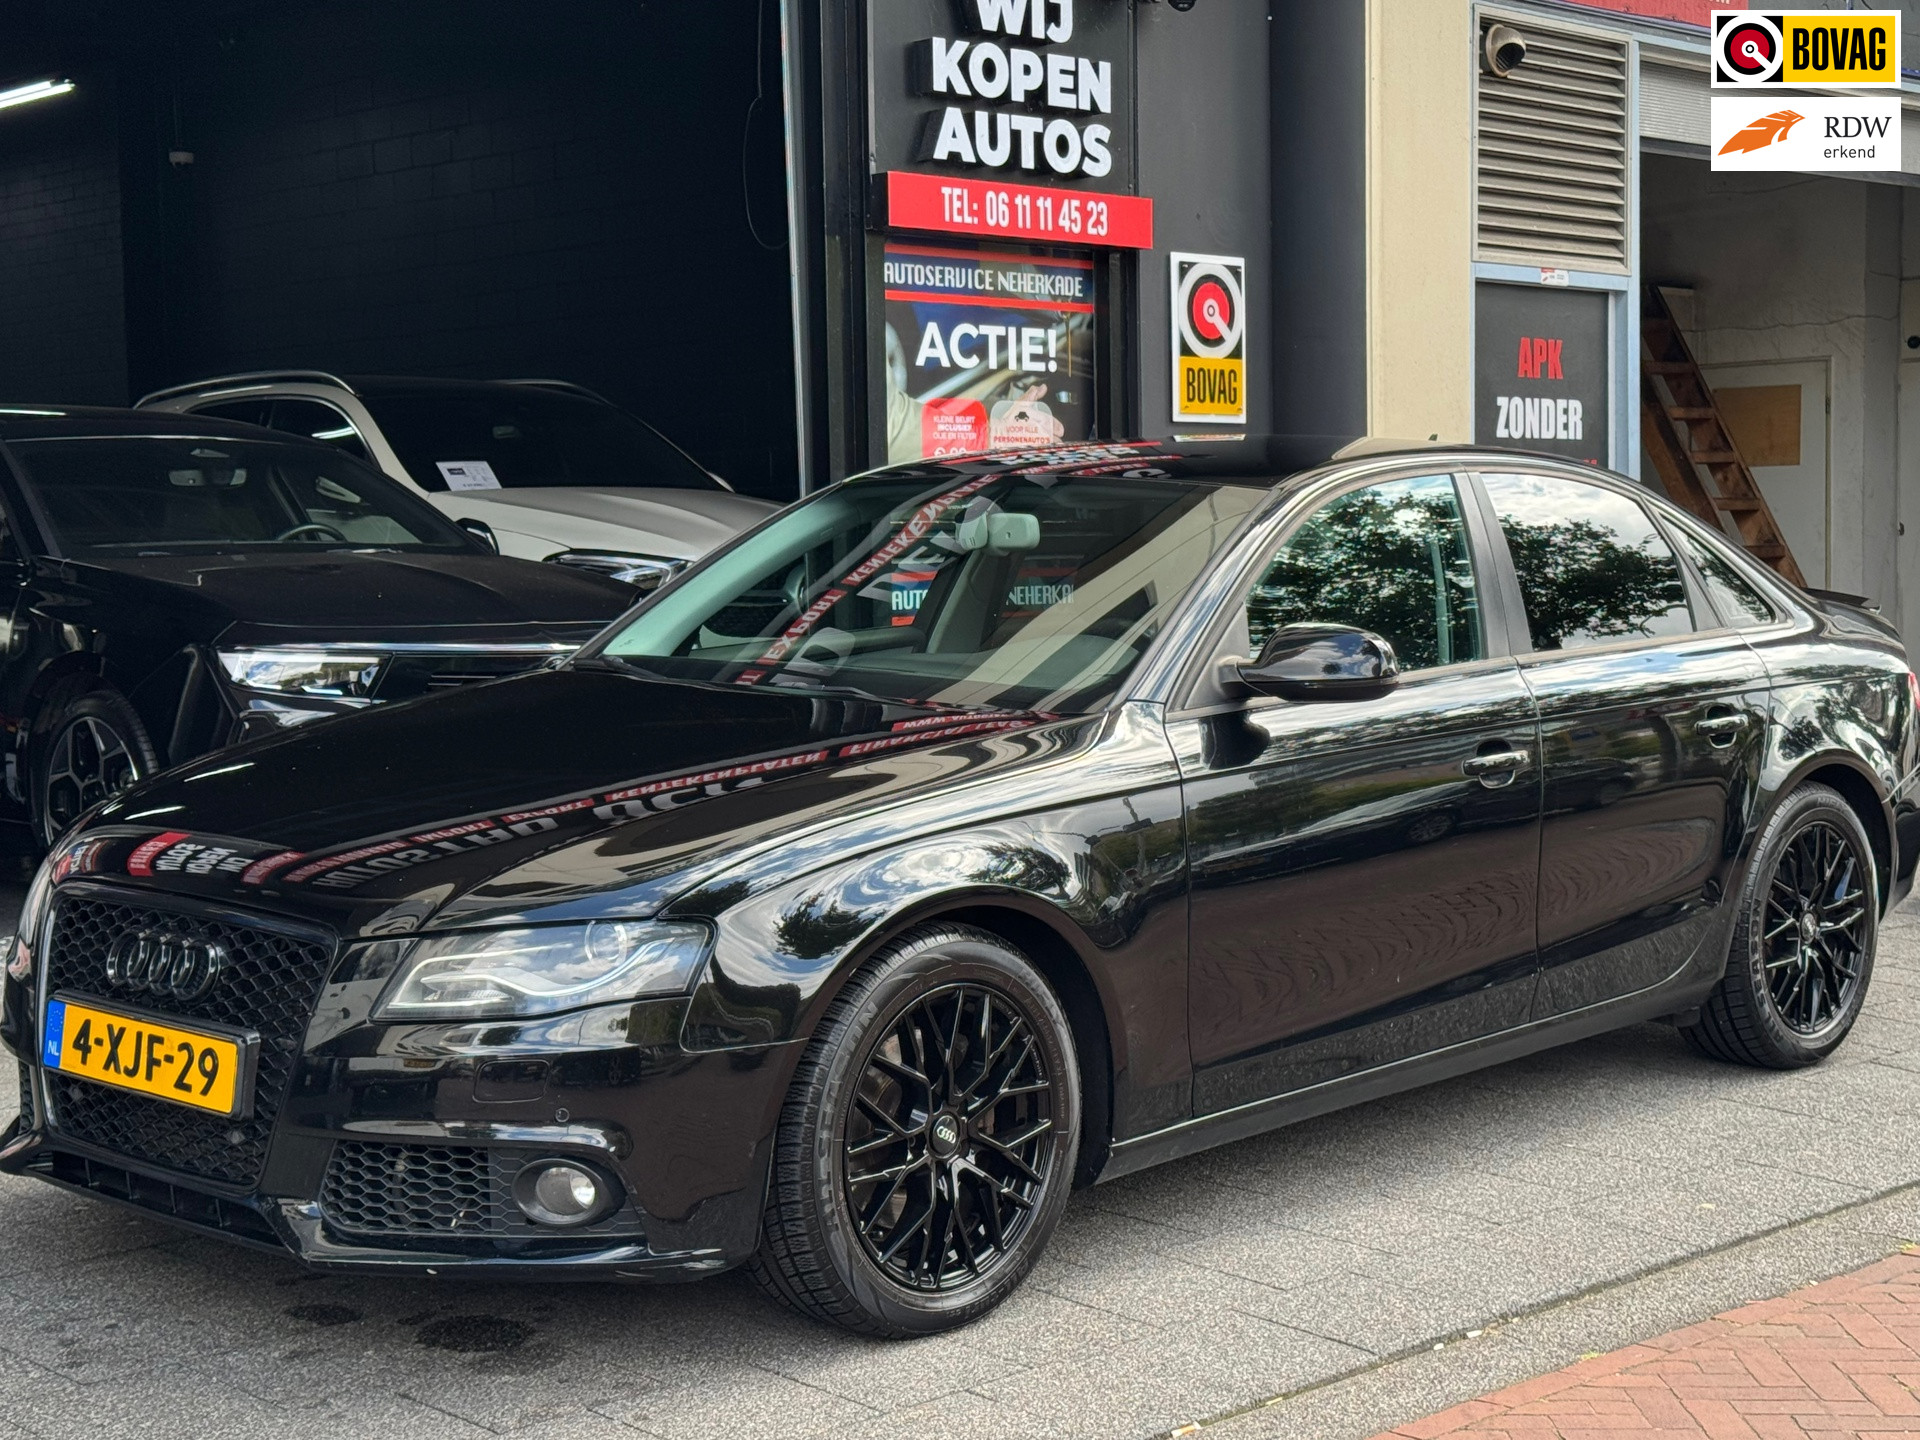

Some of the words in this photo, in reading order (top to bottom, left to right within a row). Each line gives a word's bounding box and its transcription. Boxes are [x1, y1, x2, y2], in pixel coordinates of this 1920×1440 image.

[976, 0, 1074, 43] WIJ
[932, 36, 1112, 114] KOPEN
[932, 107, 1112, 178] AUTOS
[941, 187, 979, 225] TEL:
[986, 191, 1010, 229] 06
[1014, 193, 1032, 230] 11
[1036, 195, 1054, 232] 11
[1059, 198, 1082, 235] 45
[1087, 201, 1108, 237] 23
[884, 262, 994, 292] AUTOSERVICE
[997, 270, 1083, 298] NEHERKADE
[916, 321, 1058, 373] ACTIE!
[1517, 337, 1563, 379] APK
[1186, 367, 1237, 405] BOVAG
[1496, 396, 1583, 440] ZONDER
[1006, 584, 1074, 606] NEHERKA
[47, 1040, 59, 1056] NL
[72, 1018, 219, 1097] 4-XJF-29
